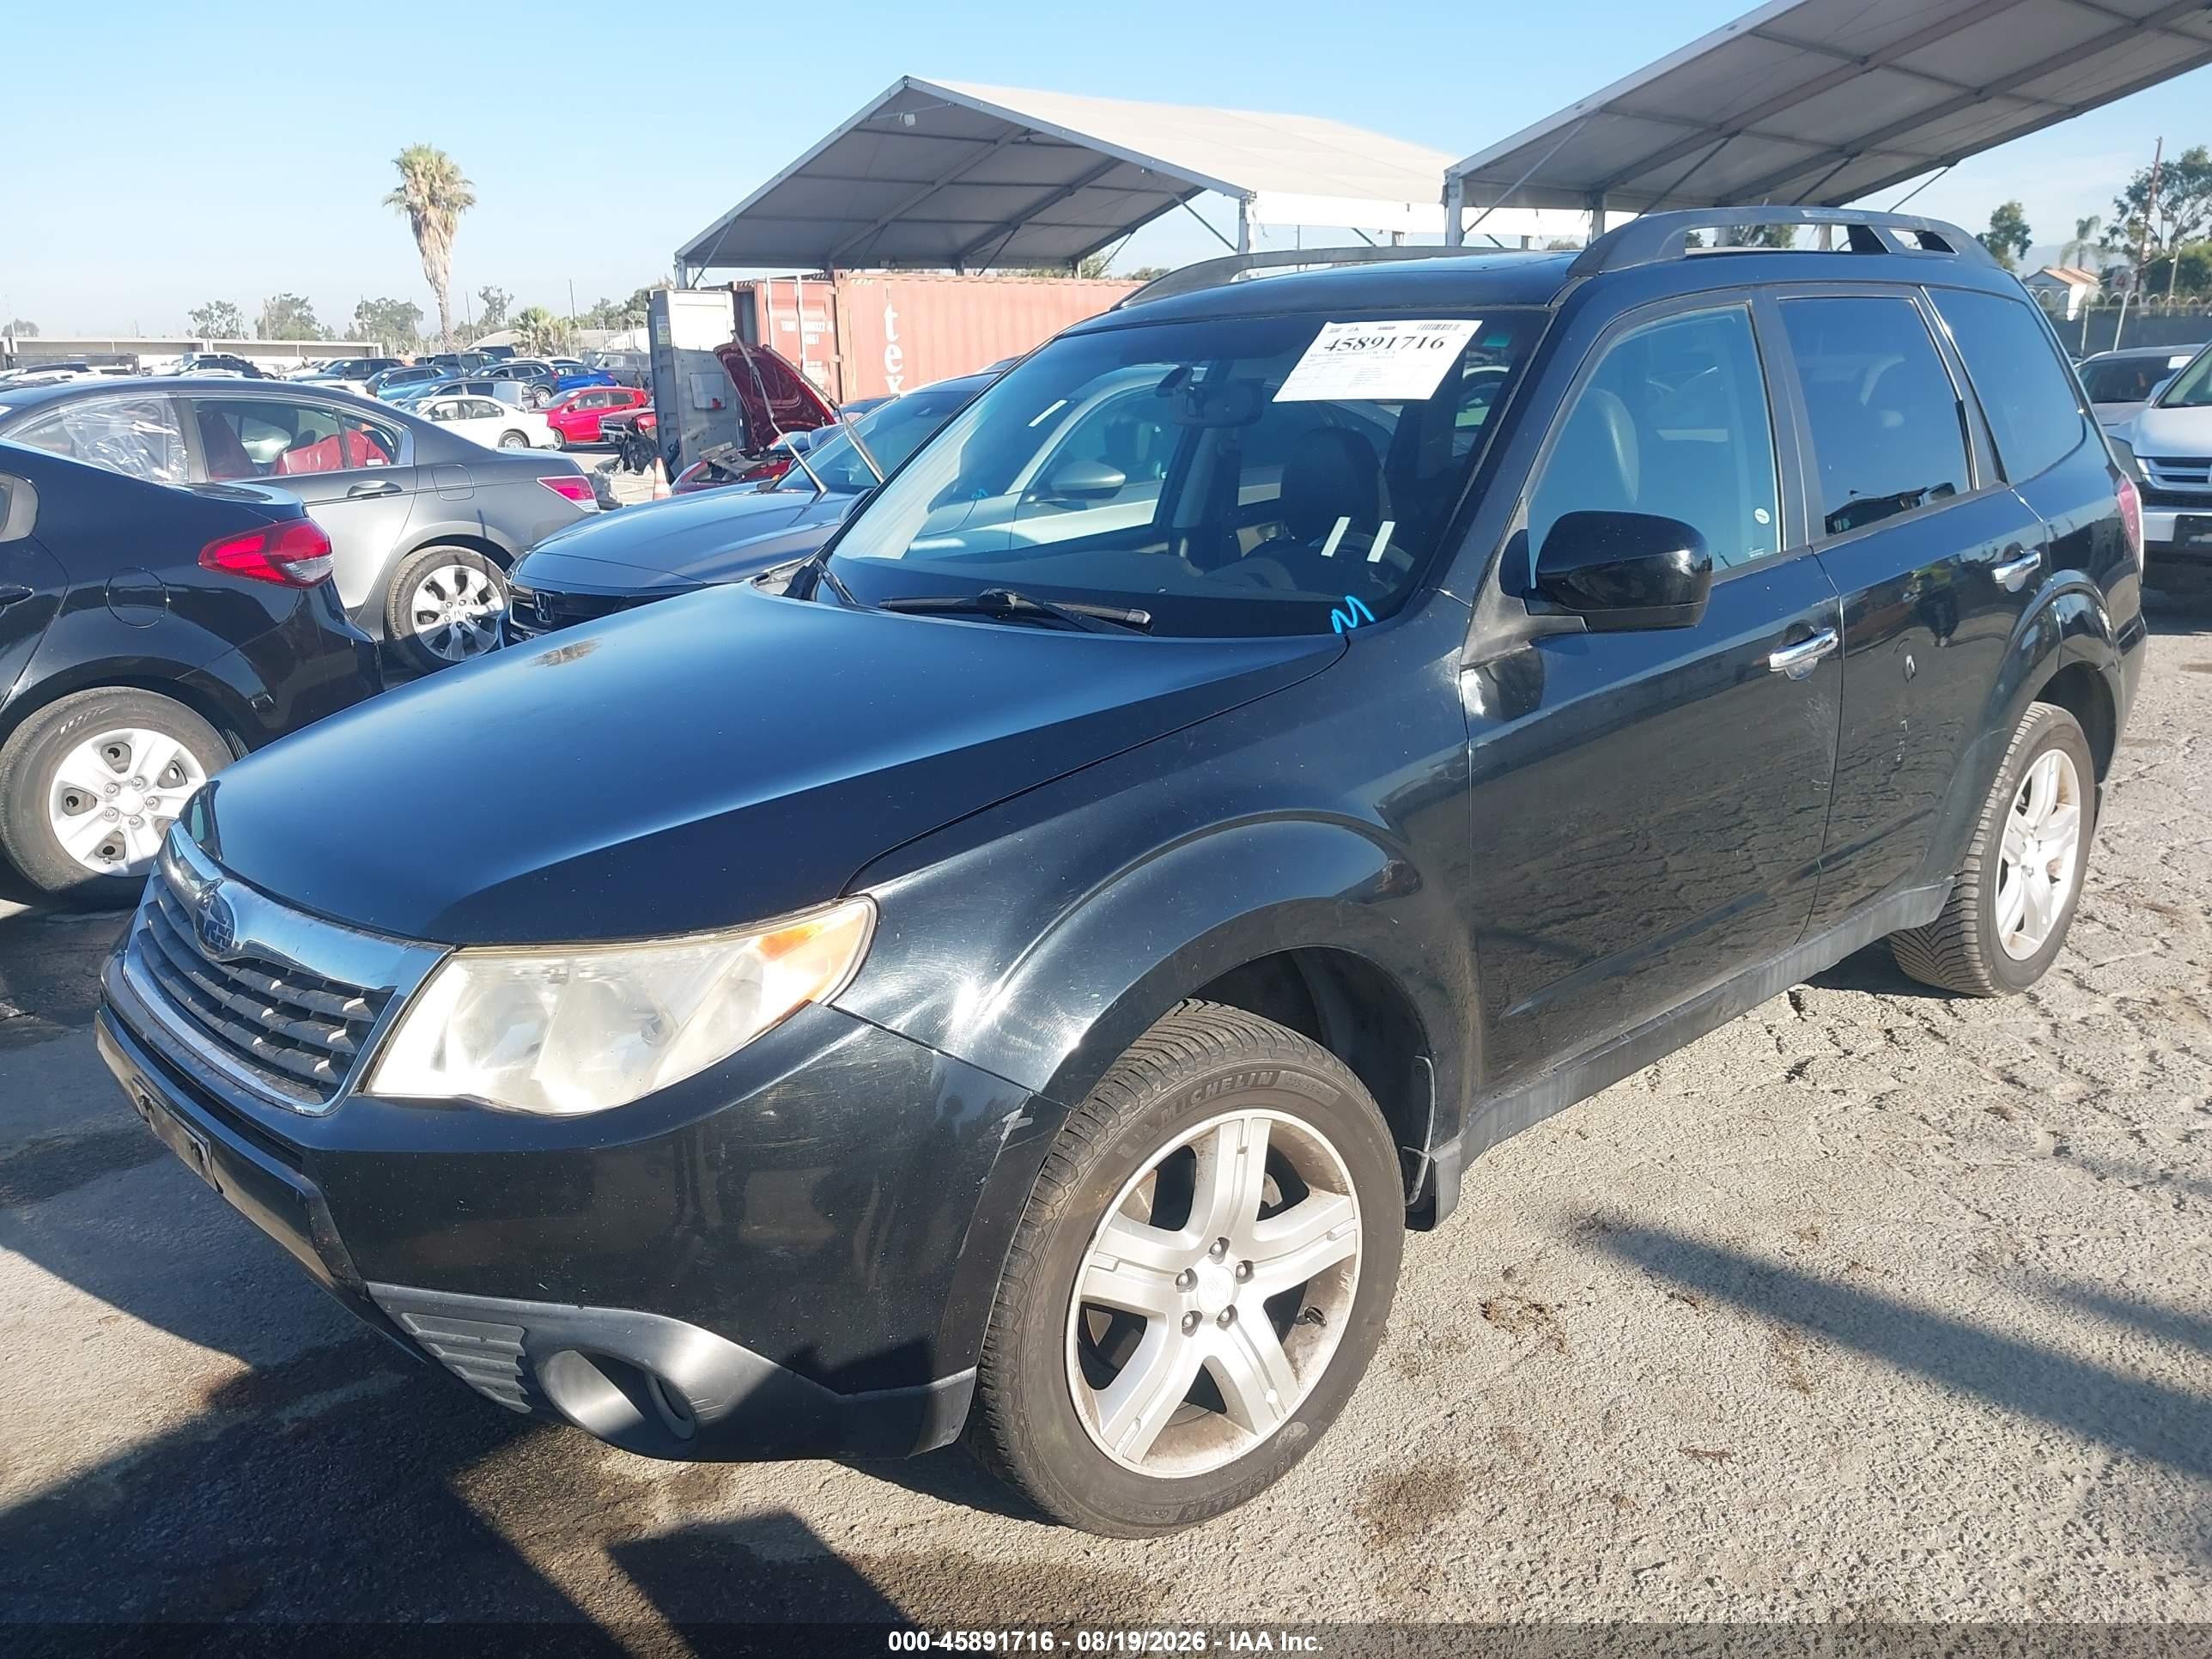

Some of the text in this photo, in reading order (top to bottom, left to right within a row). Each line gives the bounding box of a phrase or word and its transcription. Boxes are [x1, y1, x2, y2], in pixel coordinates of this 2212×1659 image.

[1323, 335, 1445, 352] 45891716
[1331, 595, 1375, 634] M
[1160, 1072, 1273, 1124] MICHELIN
